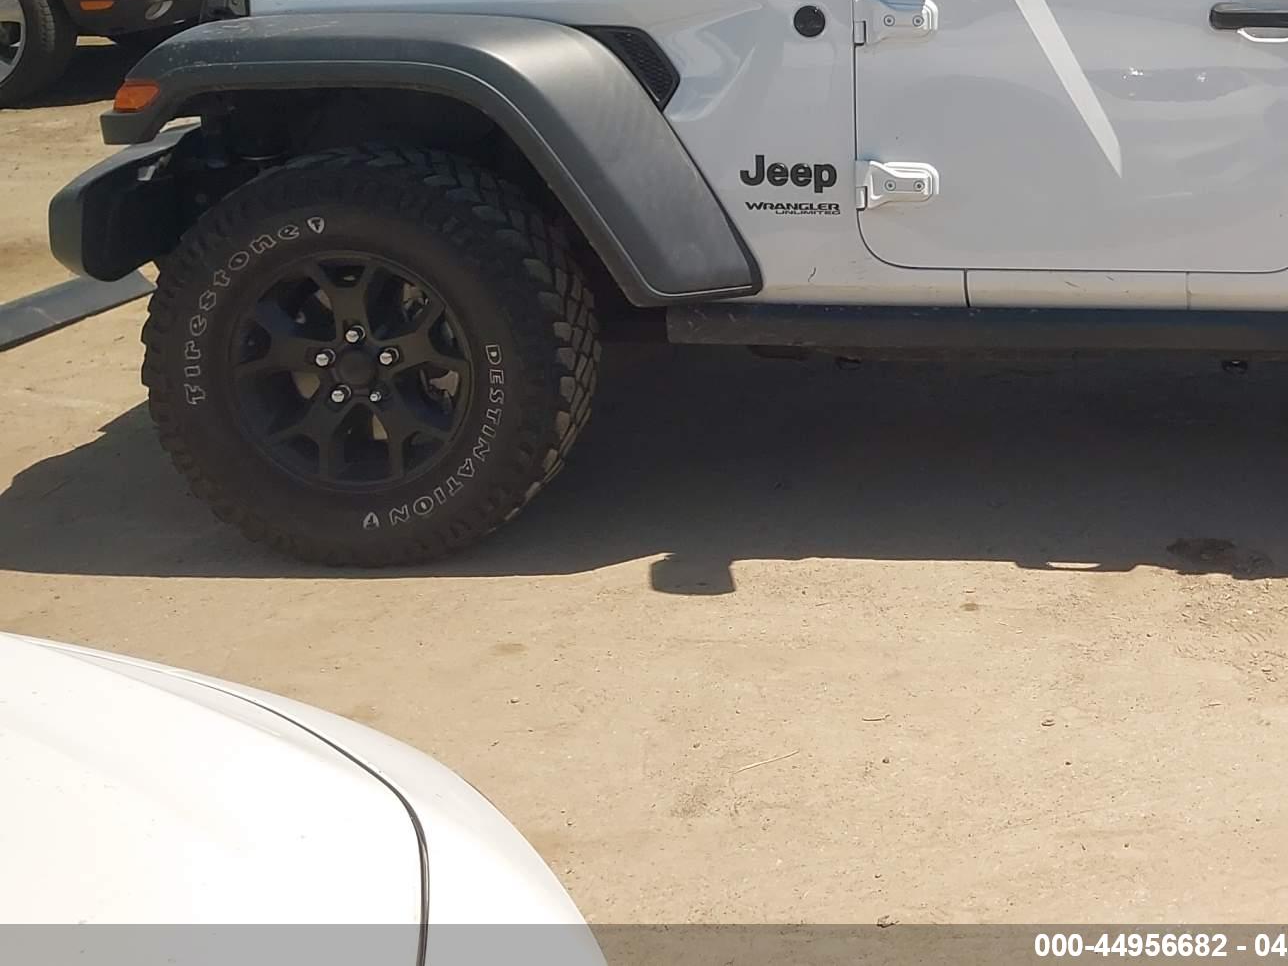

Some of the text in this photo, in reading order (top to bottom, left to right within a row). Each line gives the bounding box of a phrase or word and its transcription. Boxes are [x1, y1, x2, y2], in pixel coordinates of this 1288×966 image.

[740, 154, 837, 193] Jeep
[184, 224, 300, 405] Firestone
[389, 344, 504, 525] DESTINATION
